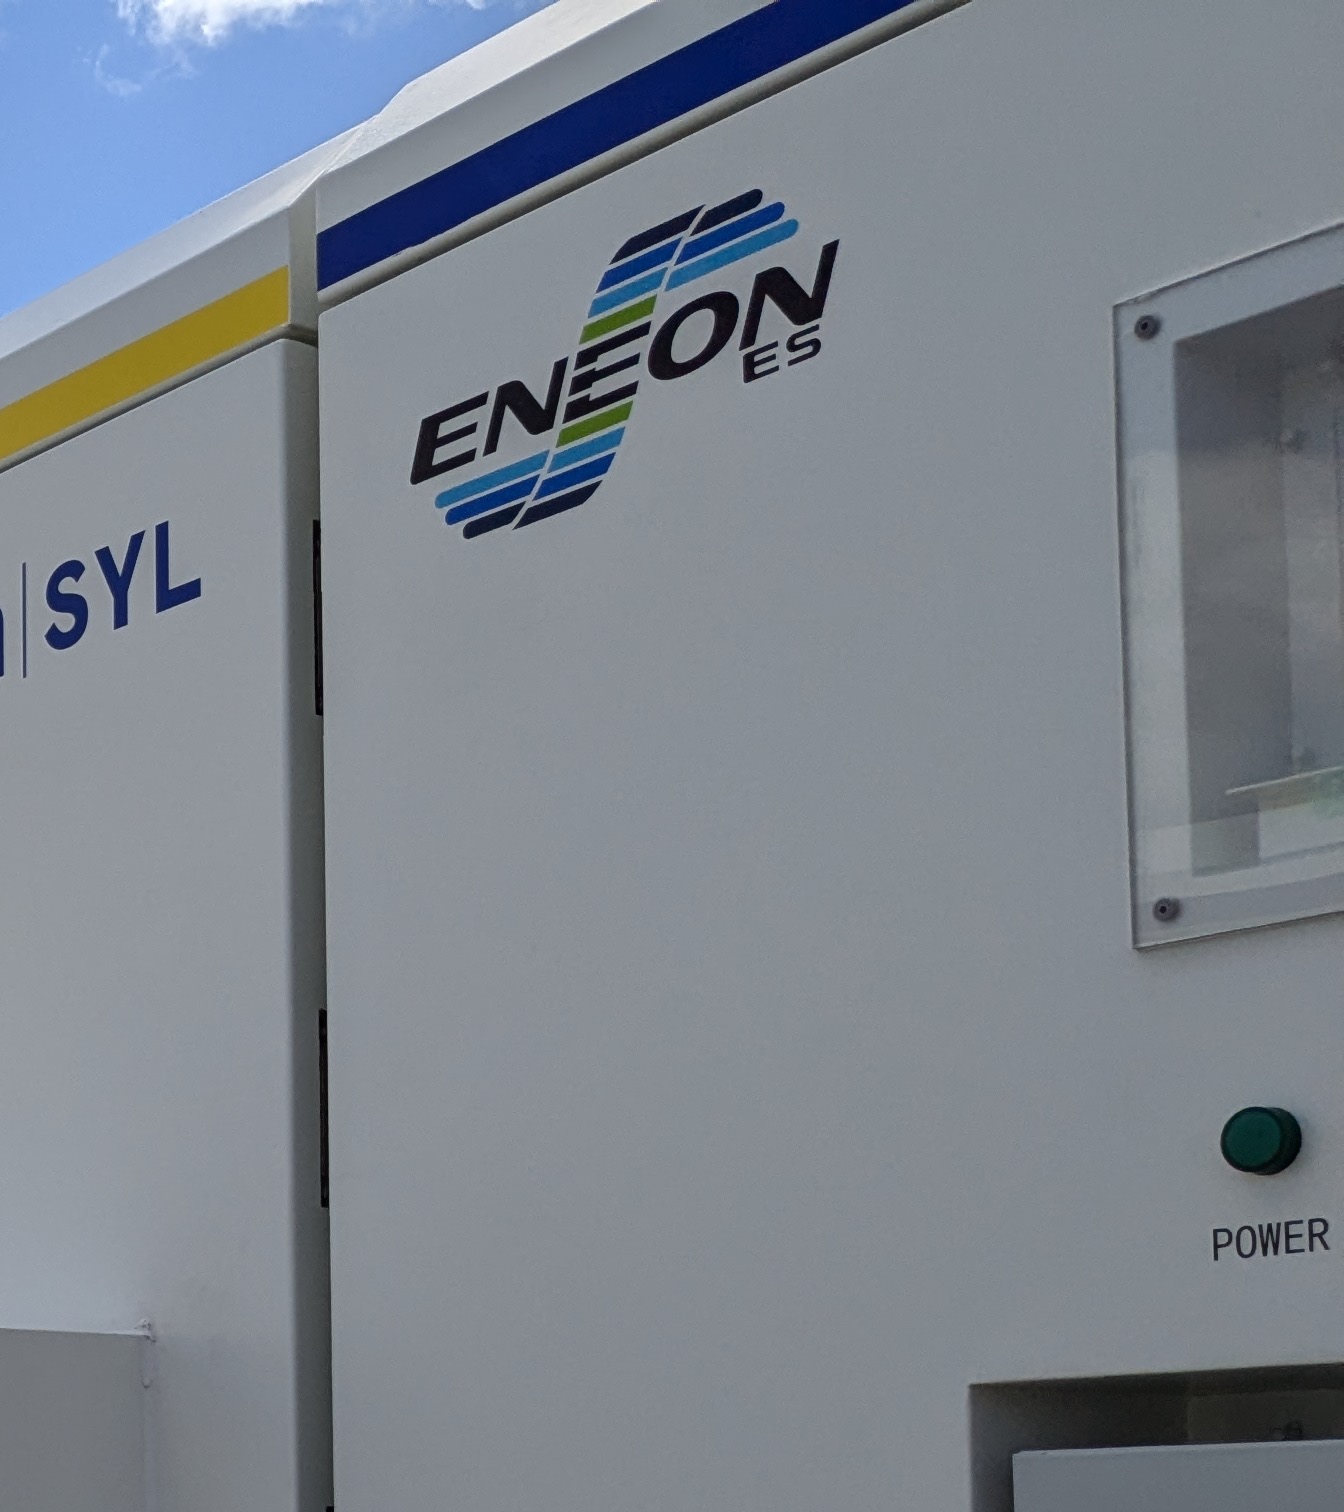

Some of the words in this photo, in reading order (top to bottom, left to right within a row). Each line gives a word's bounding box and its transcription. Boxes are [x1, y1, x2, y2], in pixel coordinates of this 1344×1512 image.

[409, 238, 840, 486] ENEON
[742, 323, 824, 383] ES
[43, 520, 202, 650] SYL
[1212, 1217, 1330, 1262] POWER
